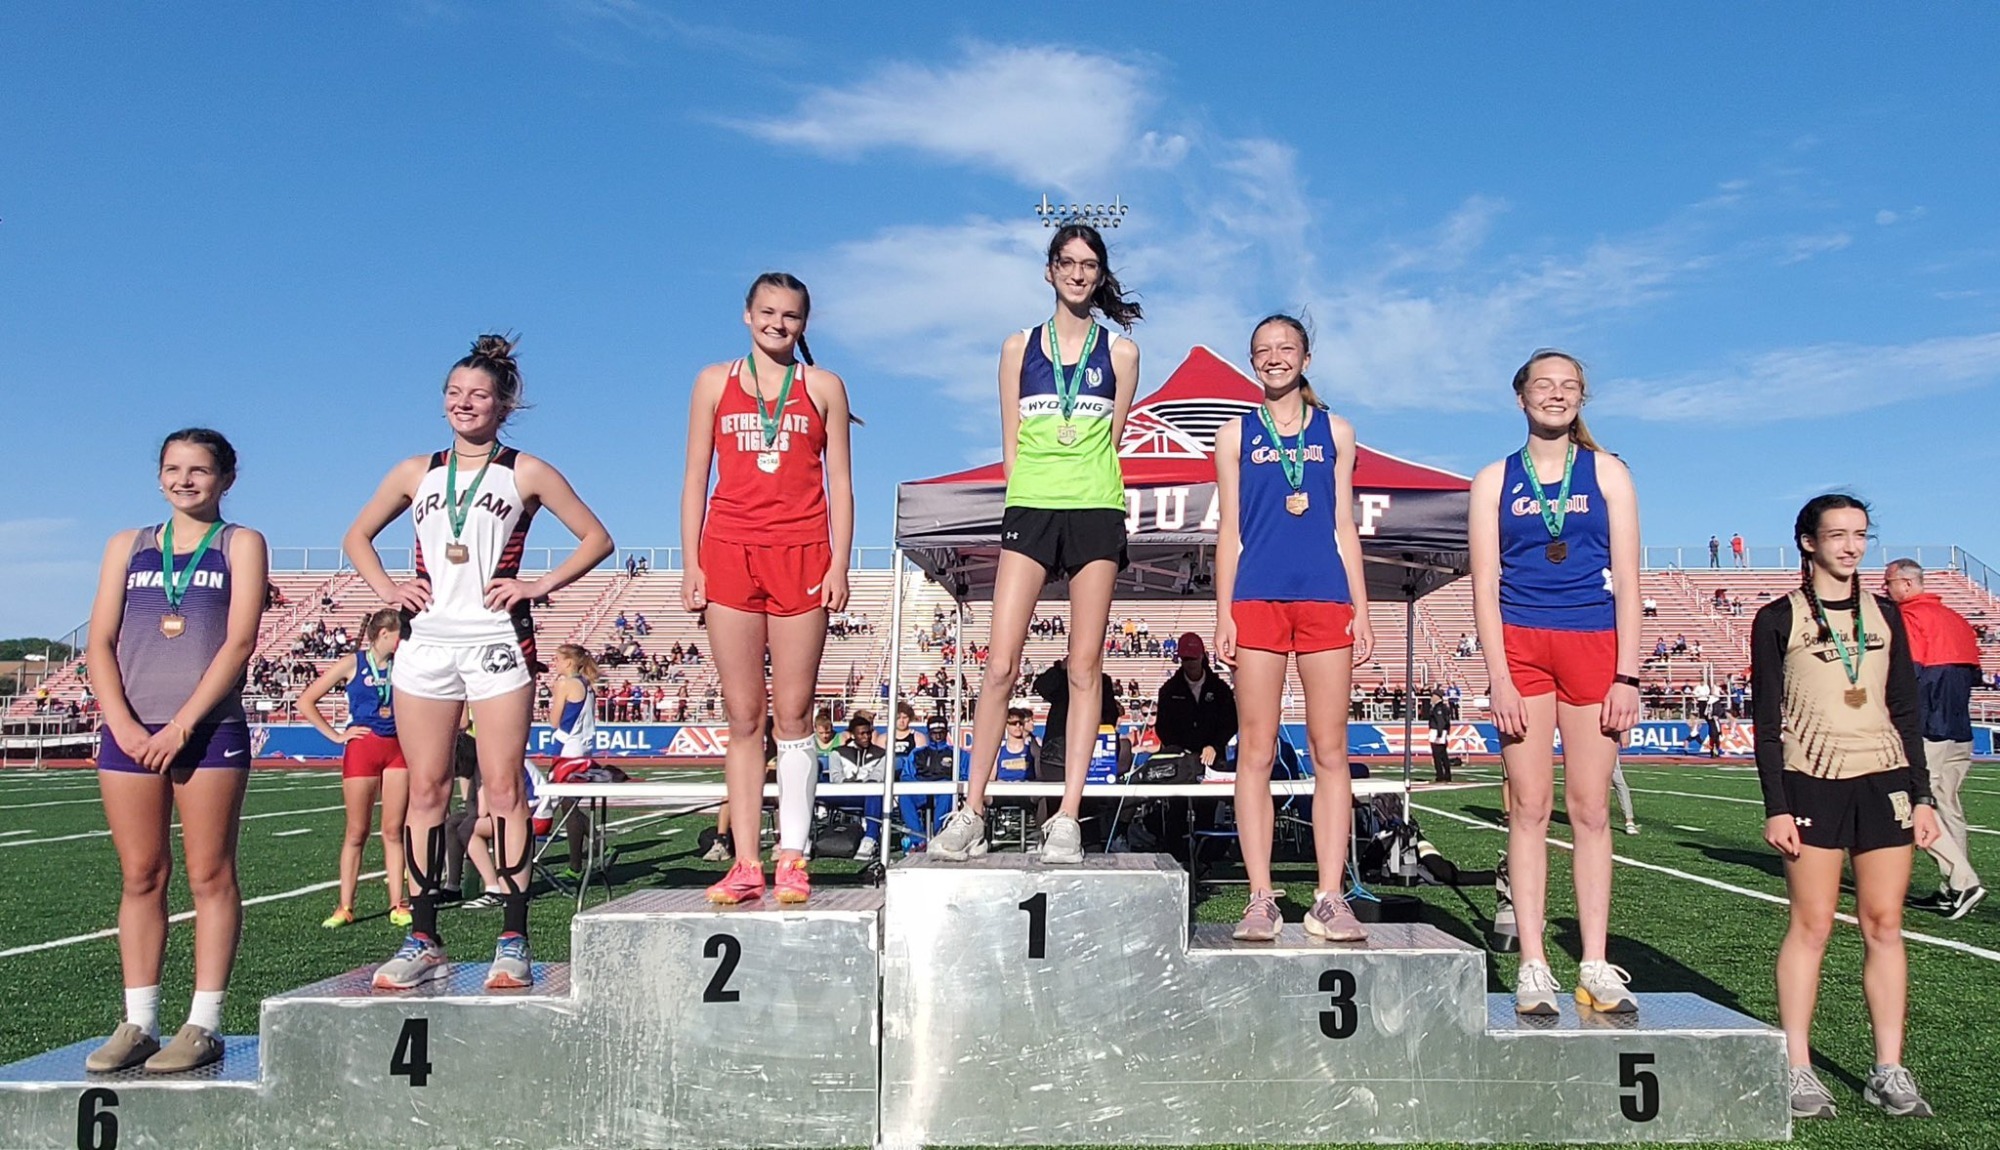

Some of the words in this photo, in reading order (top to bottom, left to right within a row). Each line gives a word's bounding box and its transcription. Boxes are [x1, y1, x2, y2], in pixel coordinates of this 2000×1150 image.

[1028, 400, 1104, 412] WYOING
[1251, 444, 1324, 464] Caroll
[1511, 494, 1589, 516] Caroll
[126, 569, 224, 590] SWANON
[538, 730, 651, 750] FBALL
[1018, 892, 1047, 960] 1
[702, 933, 742, 1003] 2
[1317, 969, 1358, 1039] 3
[389, 1018, 433, 1087] 4
[76, 1087, 120, 1150] 6
[1618, 1053, 1661, 1122] 5
